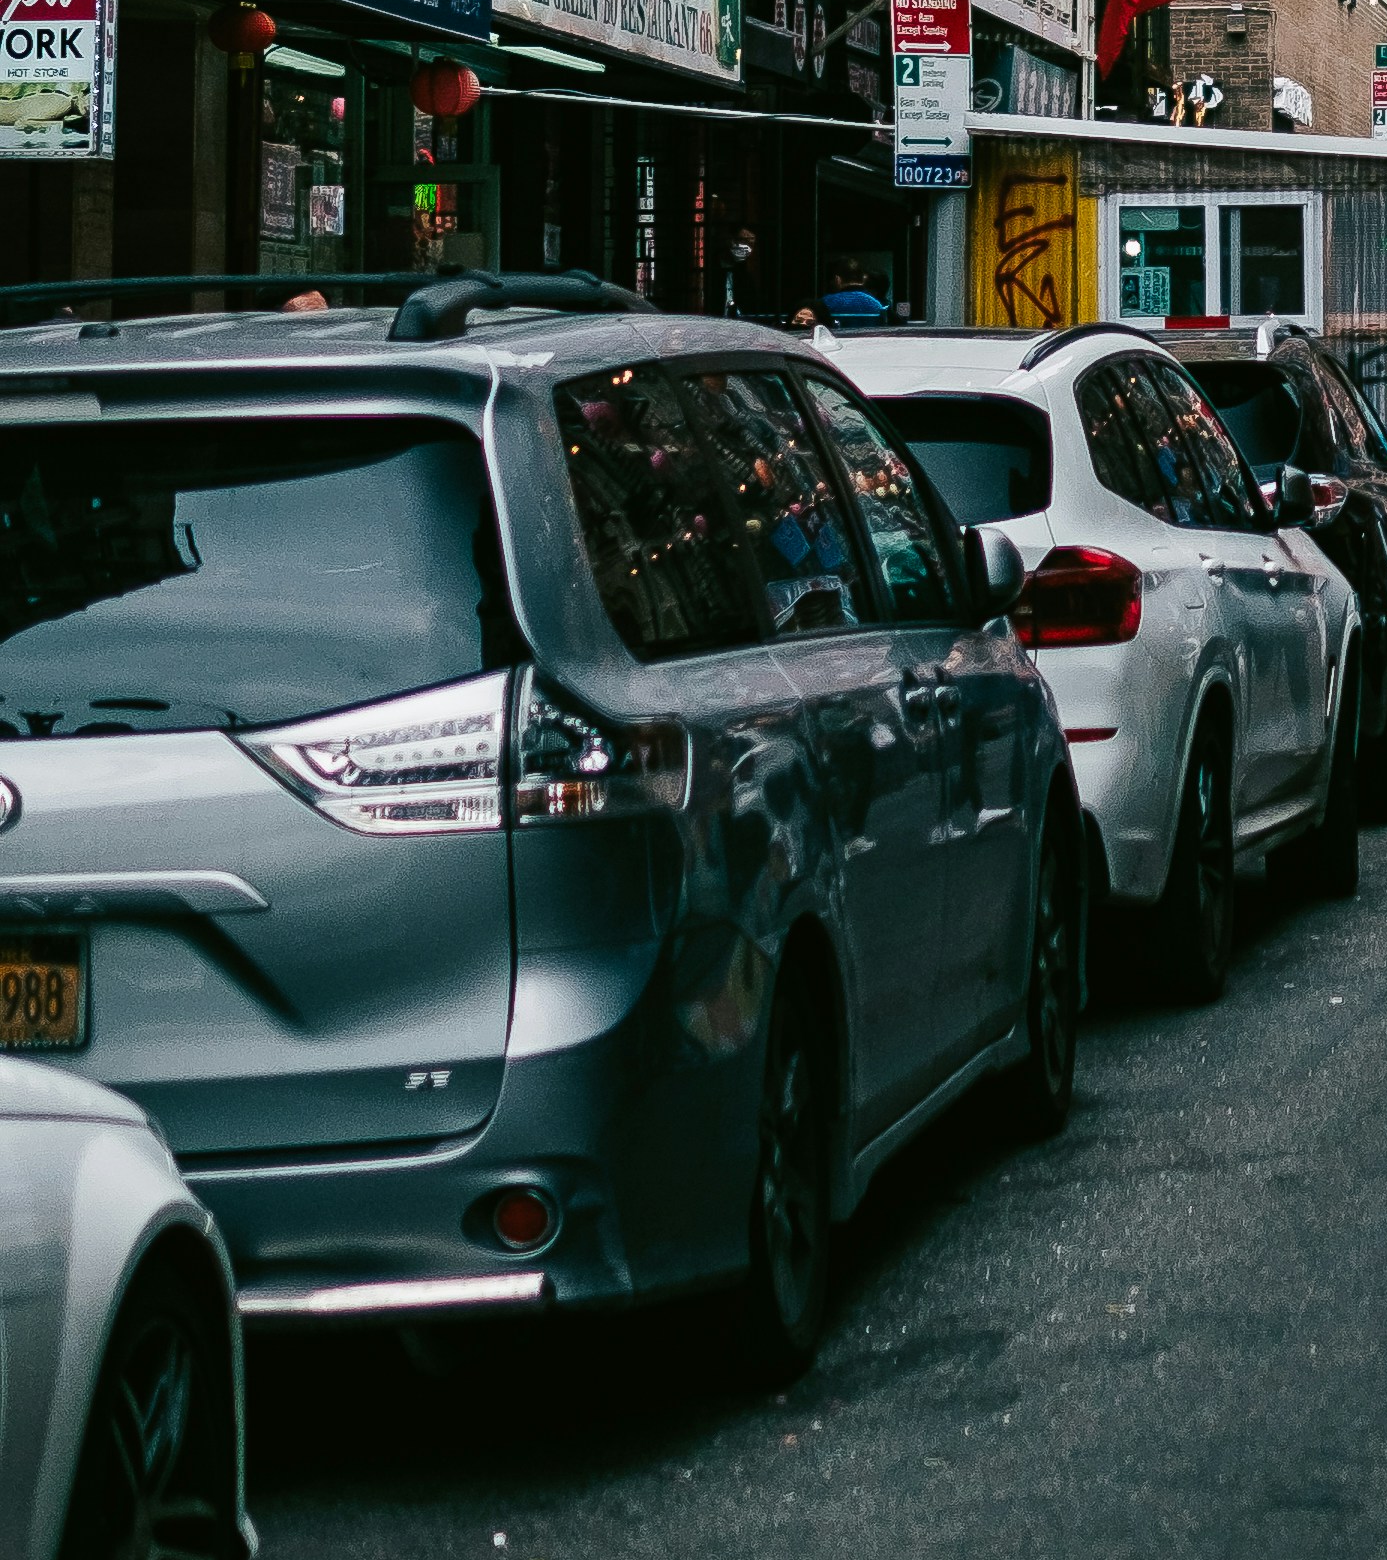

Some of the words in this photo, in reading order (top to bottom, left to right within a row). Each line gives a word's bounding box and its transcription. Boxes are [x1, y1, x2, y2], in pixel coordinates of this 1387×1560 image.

[0, 27, 84, 61] ORK
[699, 10, 714, 58] 66
[902, 57, 915, 84] 2
[1375, 109, 1384, 125] 2
[898, 166, 953, 184] 100723
